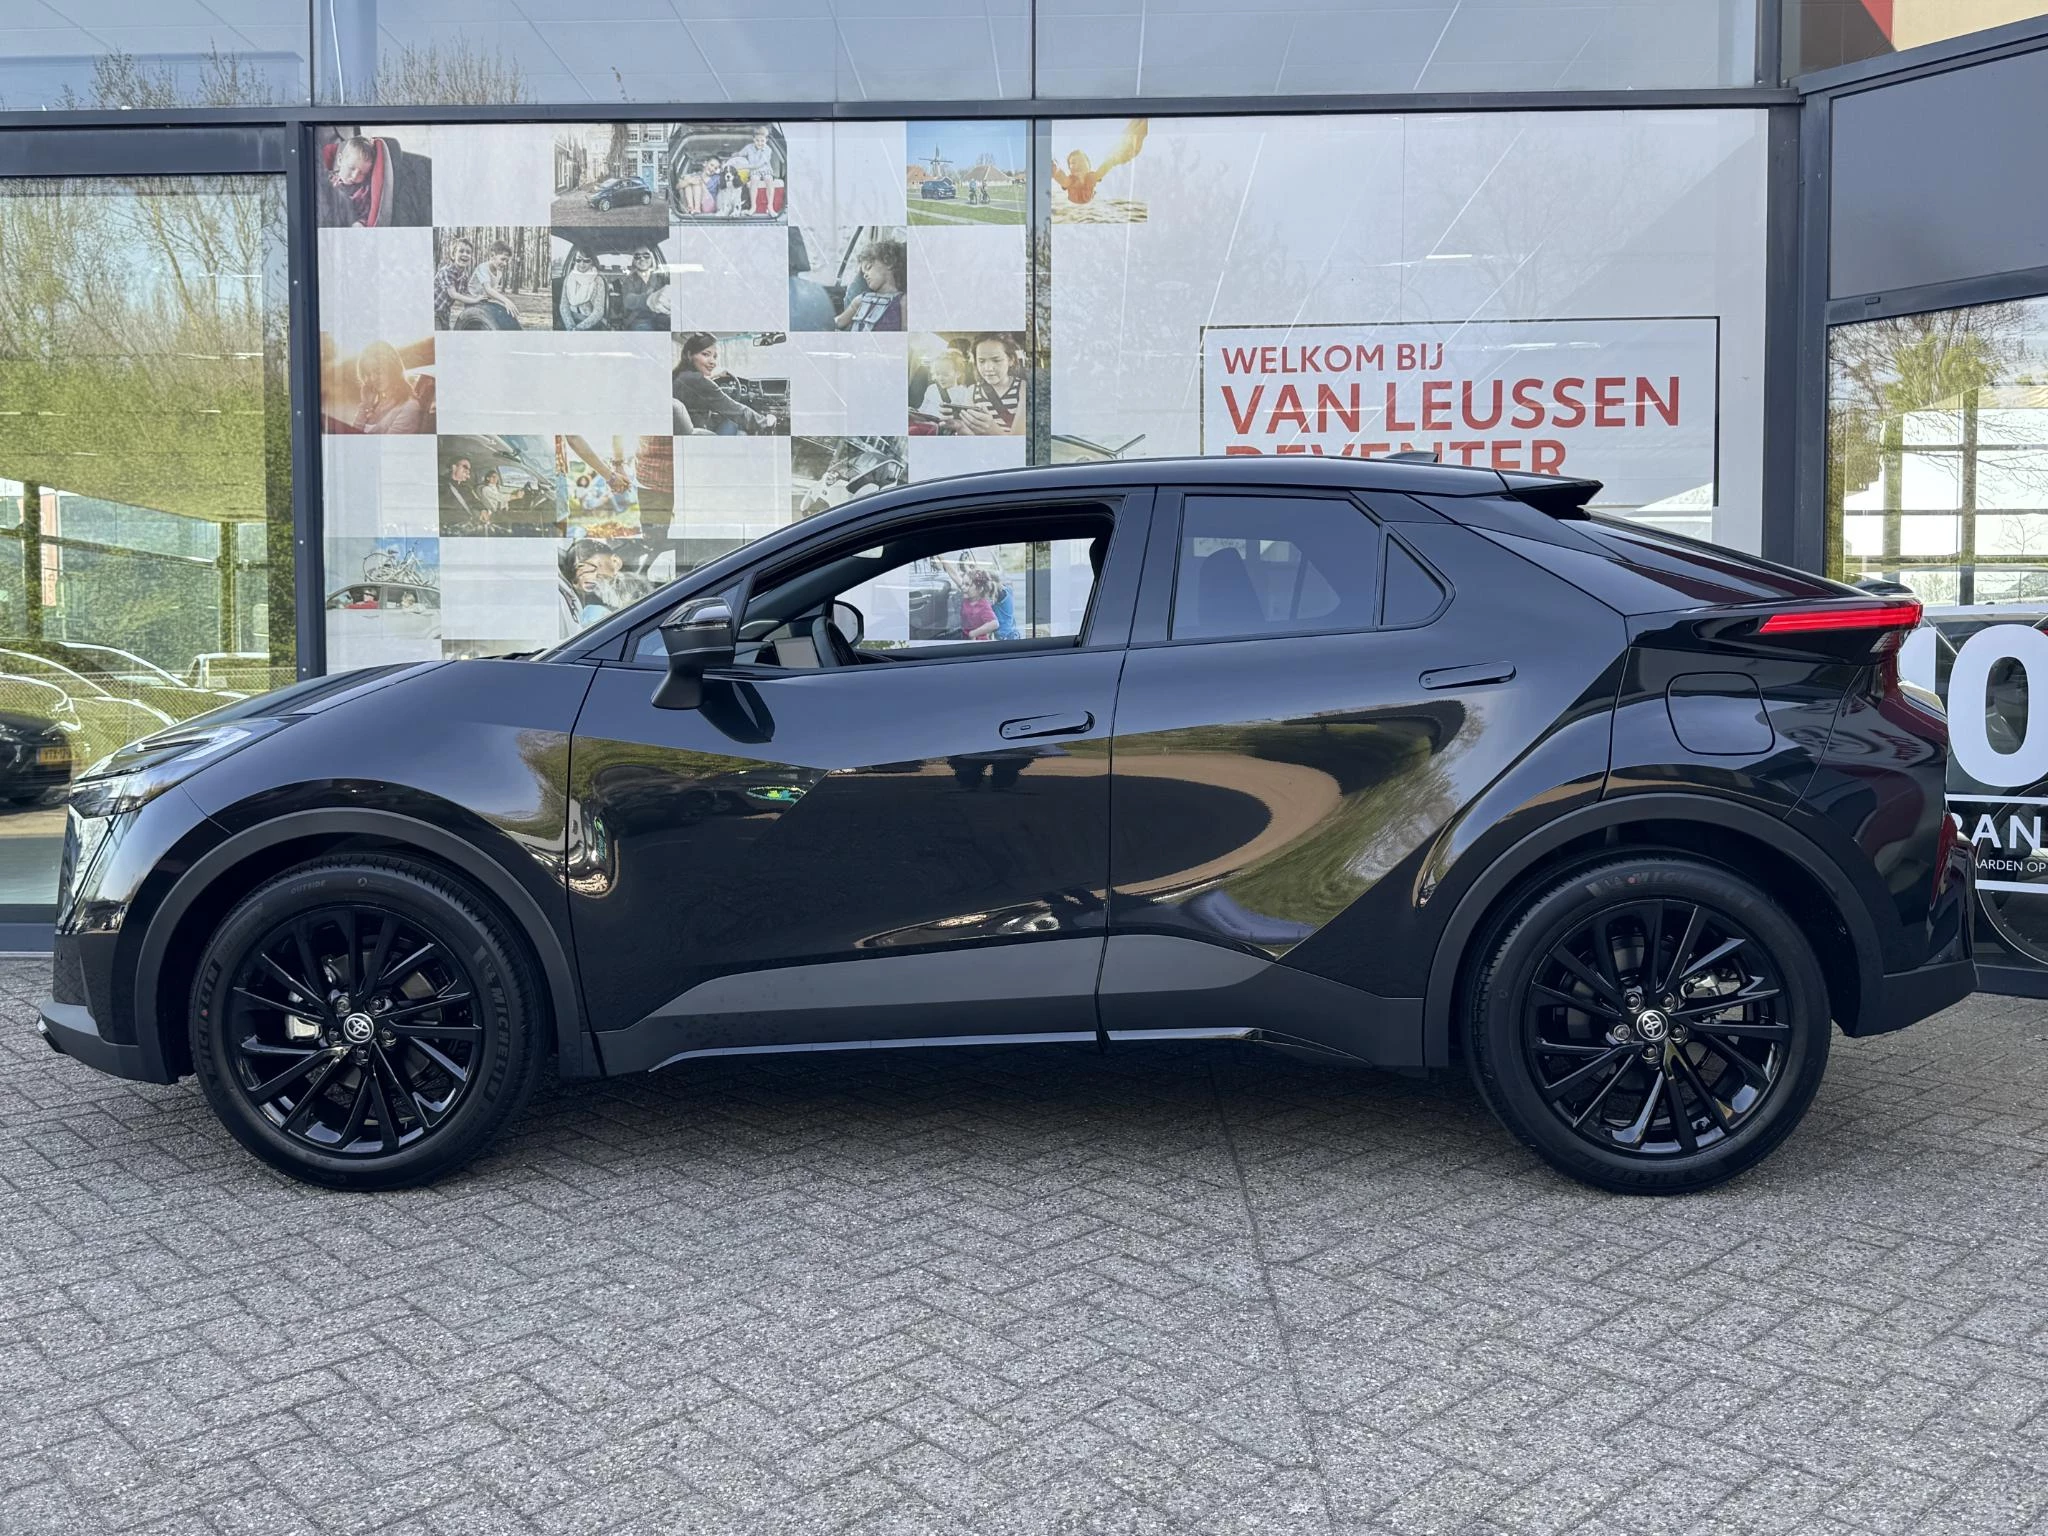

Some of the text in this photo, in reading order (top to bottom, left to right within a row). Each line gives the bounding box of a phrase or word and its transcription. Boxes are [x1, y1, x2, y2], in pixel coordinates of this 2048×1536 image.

[1222, 343, 1443, 374] WELKOM BIJ
[1221, 376, 1679, 435] VAN LEUSSEN
[1951, 812, 2042, 850] AN
[2027, 861, 2047, 873] OP
[484, 985, 510, 1098] MICHELIN
